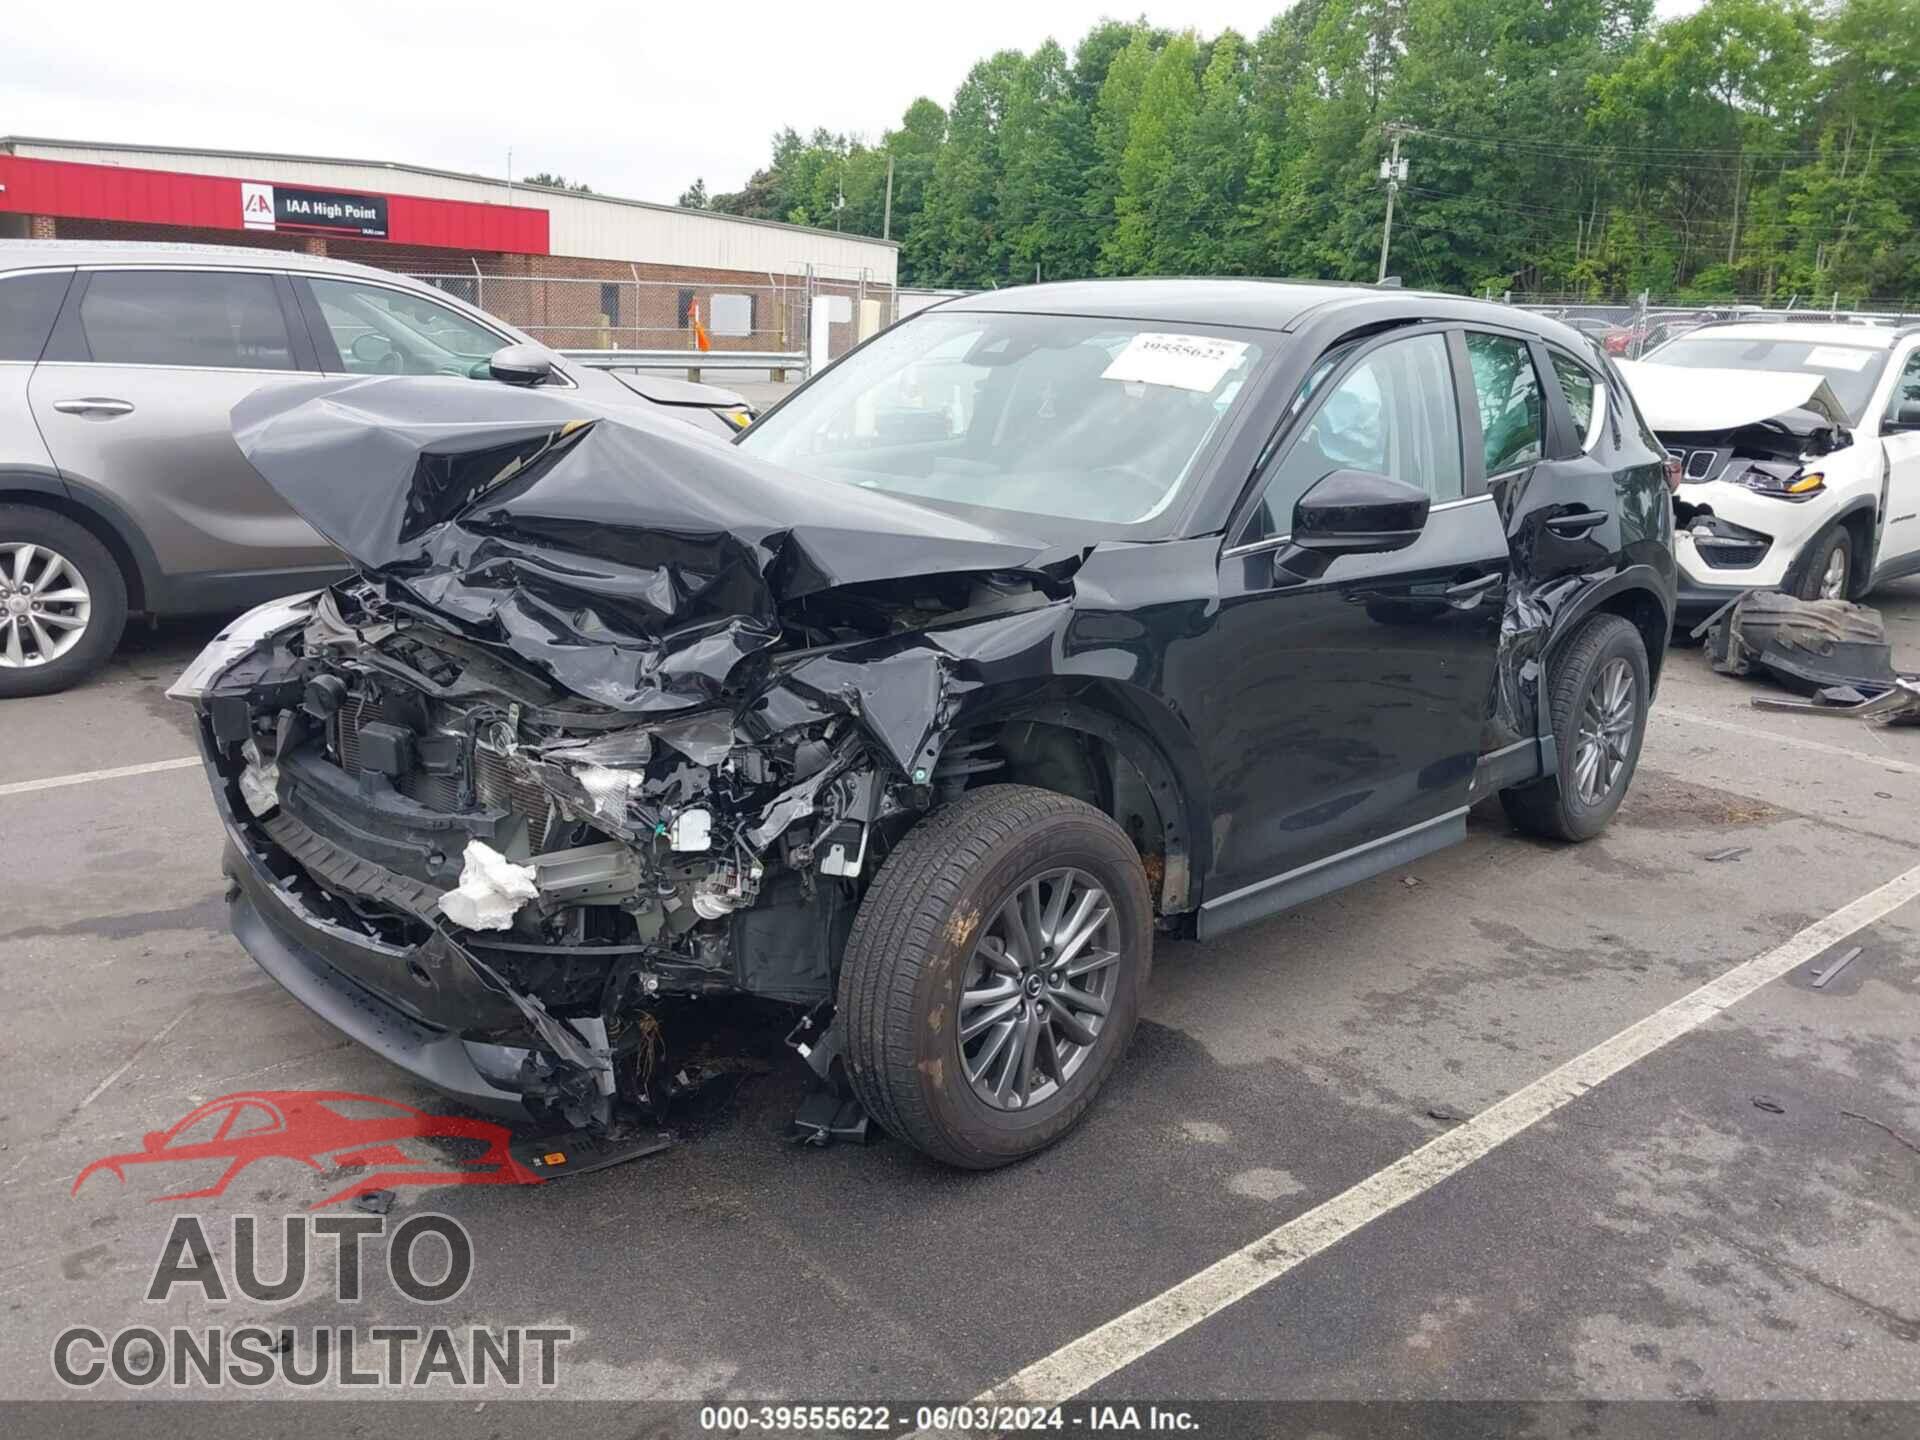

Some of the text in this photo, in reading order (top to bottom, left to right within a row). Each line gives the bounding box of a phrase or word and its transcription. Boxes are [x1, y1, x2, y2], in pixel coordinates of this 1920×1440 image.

[286, 199, 376, 220] IAA High Point
